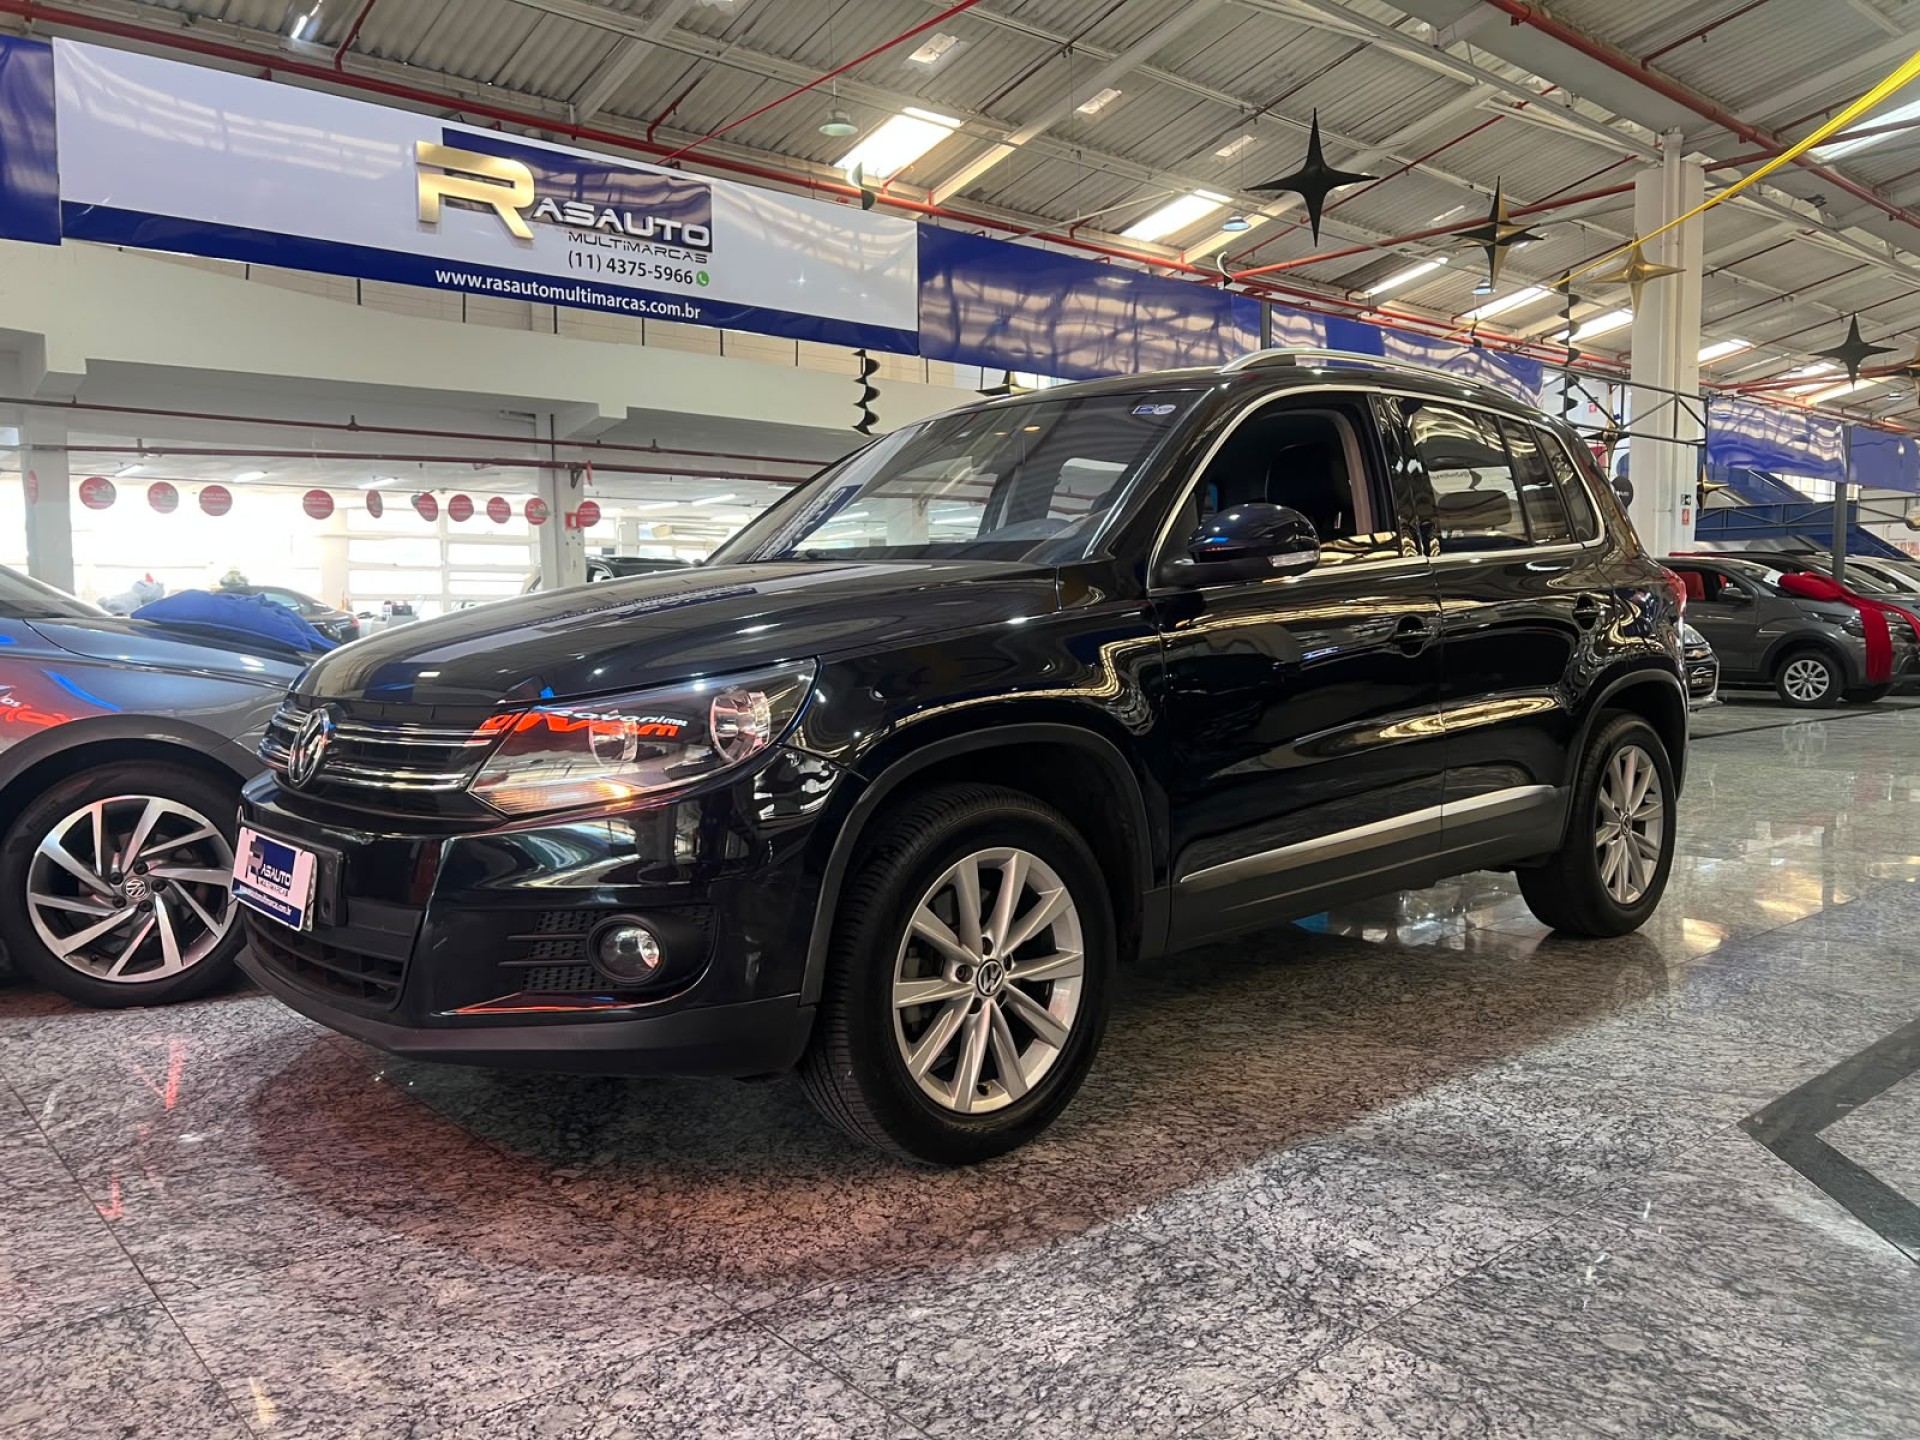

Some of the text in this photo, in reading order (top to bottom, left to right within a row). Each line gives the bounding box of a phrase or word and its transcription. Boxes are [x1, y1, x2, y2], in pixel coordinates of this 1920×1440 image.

[568, 250, 693, 285] (11) 4375-5966
[435, 268, 701, 320] www.rasautomultimarcas.com.br
